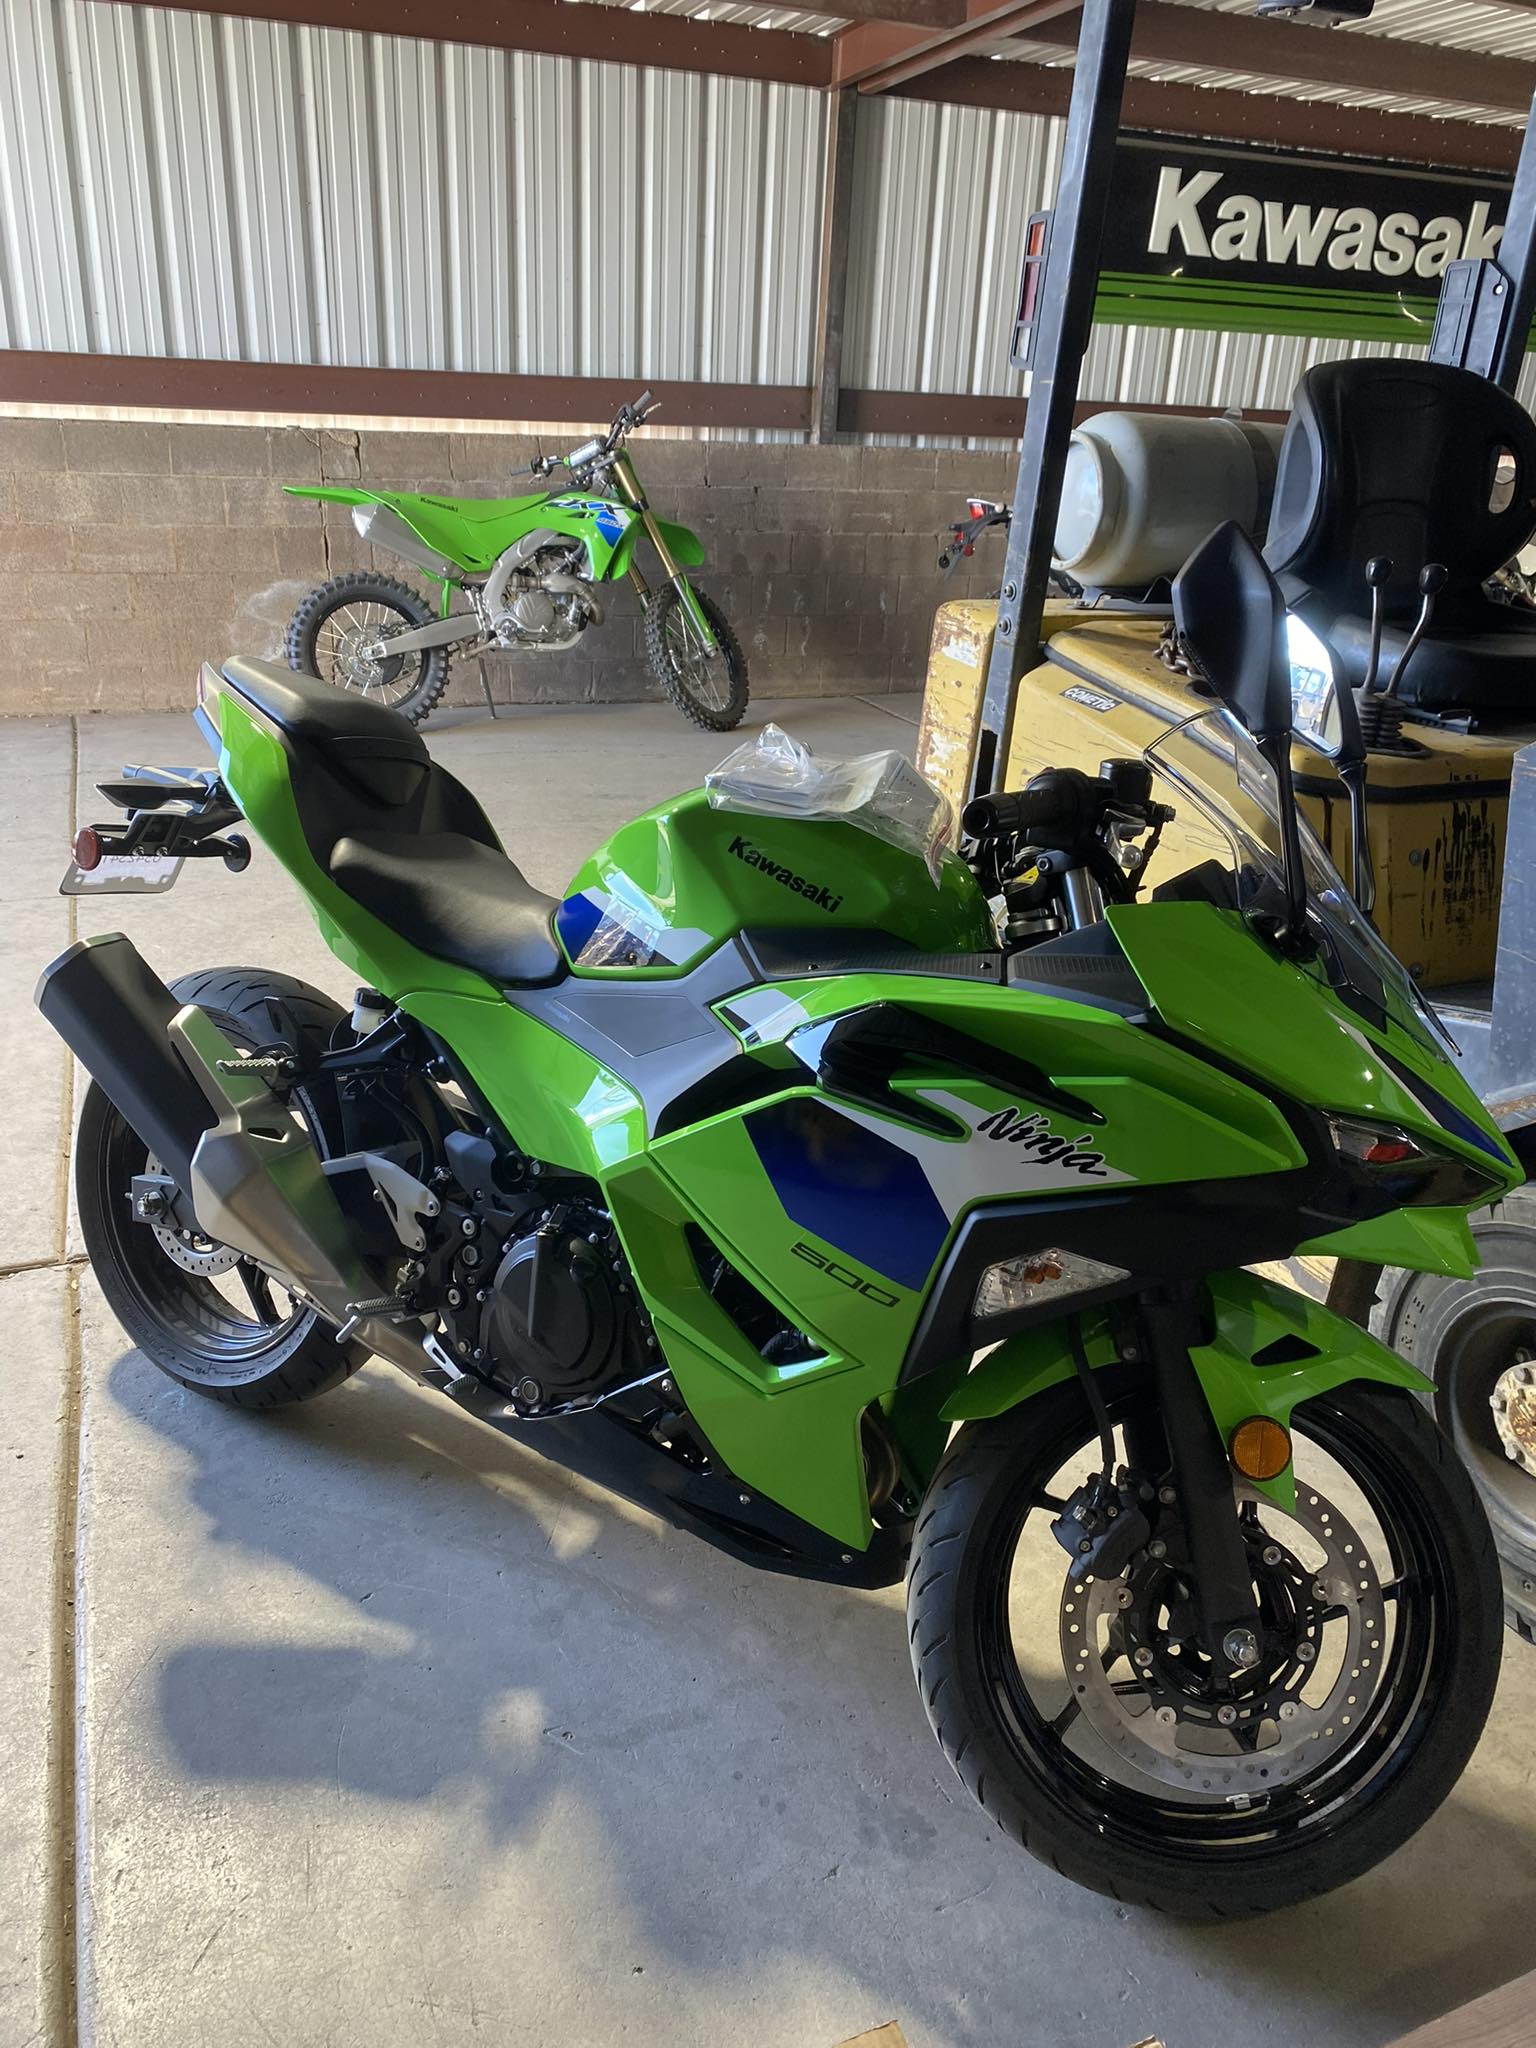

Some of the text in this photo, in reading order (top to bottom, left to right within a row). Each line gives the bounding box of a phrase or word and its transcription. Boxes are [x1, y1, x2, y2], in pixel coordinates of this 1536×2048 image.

[1148, 166, 1506, 279] Kawasak
[727, 835, 844, 913] Kawasaki
[976, 1107, 1108, 1177] Ninja
[790, 1241, 901, 1308] 500
